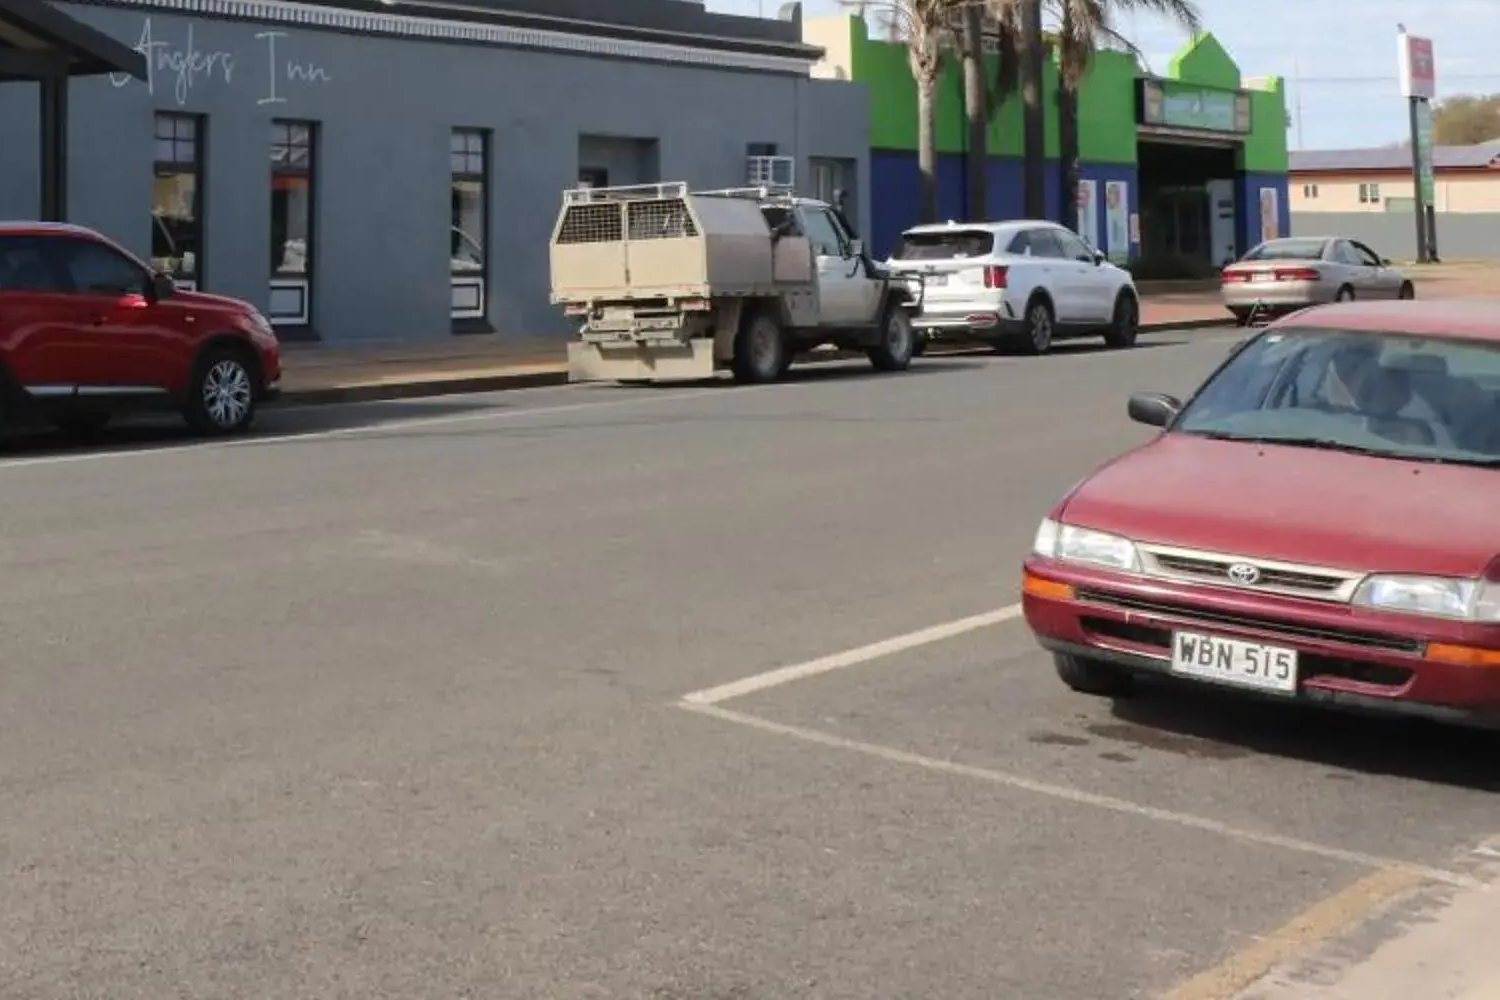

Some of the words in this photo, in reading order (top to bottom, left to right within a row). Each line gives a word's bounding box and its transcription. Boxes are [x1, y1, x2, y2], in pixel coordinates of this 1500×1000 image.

[109, 17, 235, 104] Anglers
[253, 31, 333, 104] Inn
[1180, 635, 1233, 670] WBN
[1244, 646, 1291, 680] 515
